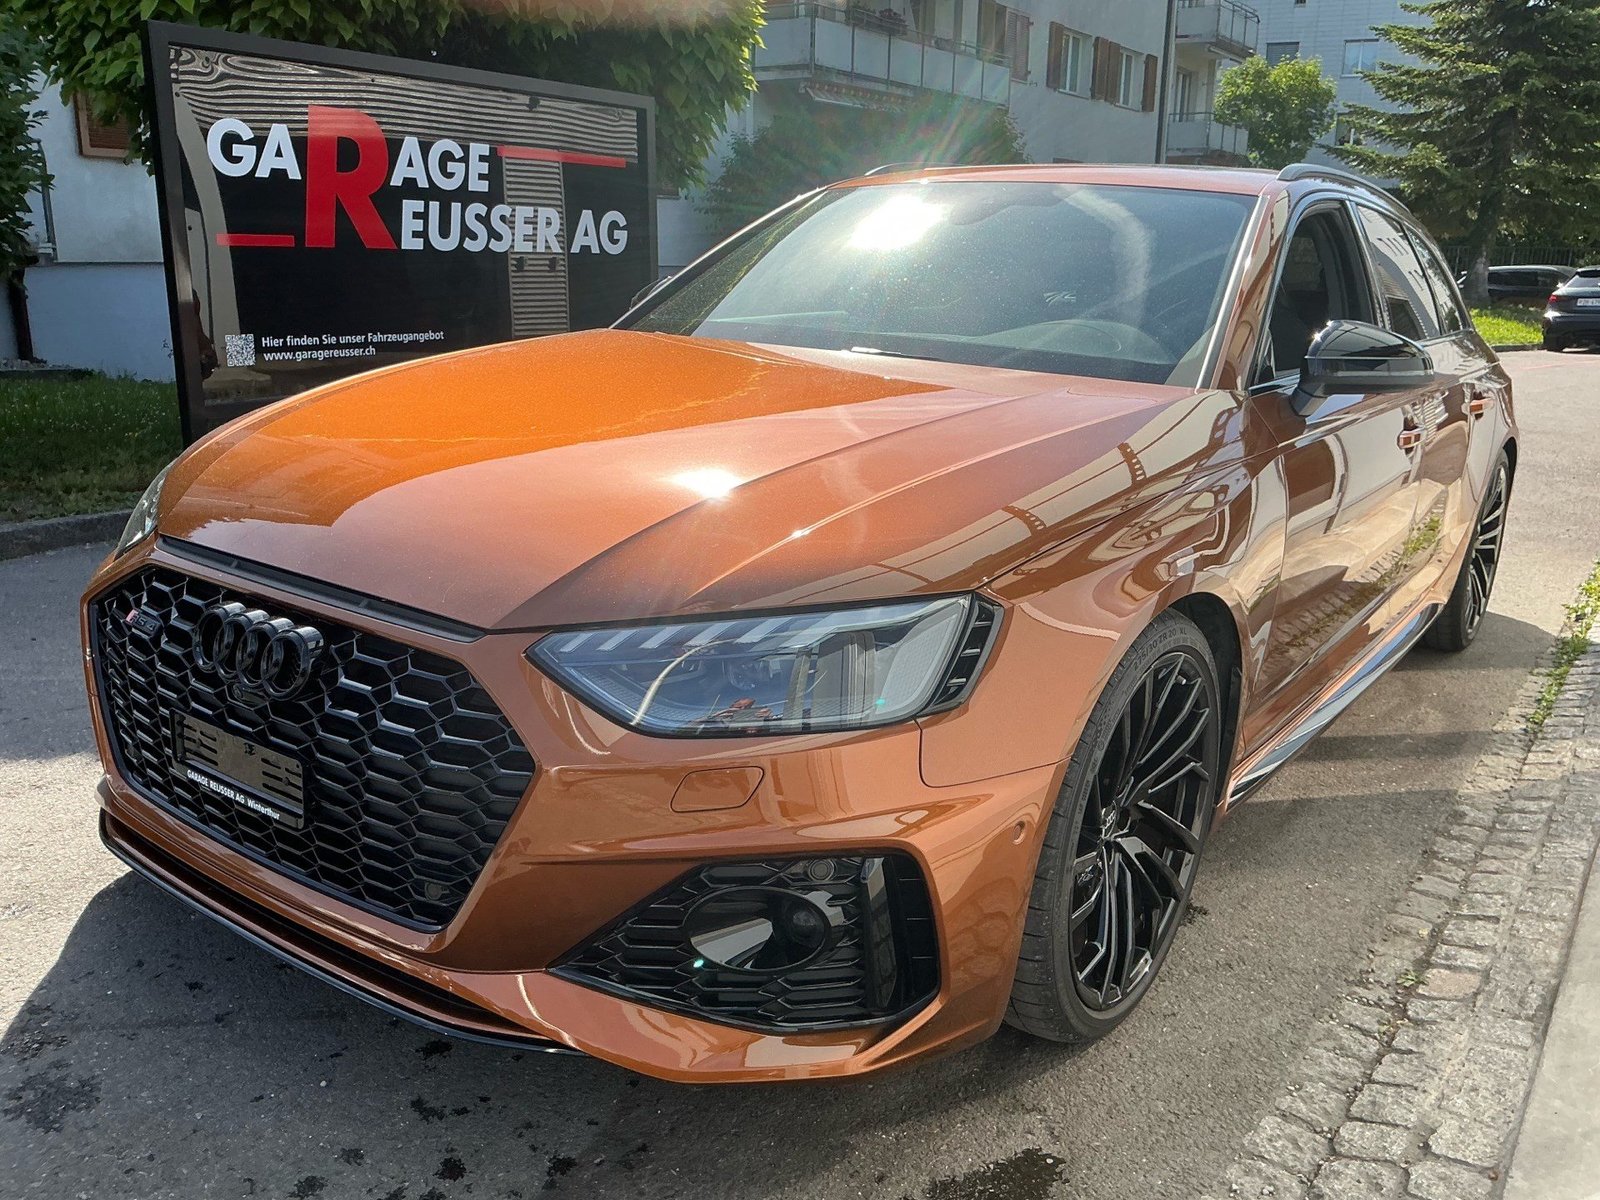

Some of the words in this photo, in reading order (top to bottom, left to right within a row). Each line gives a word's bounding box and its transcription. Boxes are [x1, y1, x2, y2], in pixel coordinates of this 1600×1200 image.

[206, 104, 491, 250] GARAGE
[571, 209, 629, 256] AG
[261, 336, 284, 348] Hier
[286, 334, 320, 347] finden
[322, 334, 337, 345] Sie
[339, 335, 366, 344] unser
[367, 330, 445, 344] Fahrzeugangebot
[263, 345, 376, 362] www.garagereusser.ch
[187, 769, 209, 787] GARAGE
[209, 780, 235, 800] REUSSER
[235, 793, 245, 804] AG
[247, 797, 280, 820] Winterthur
